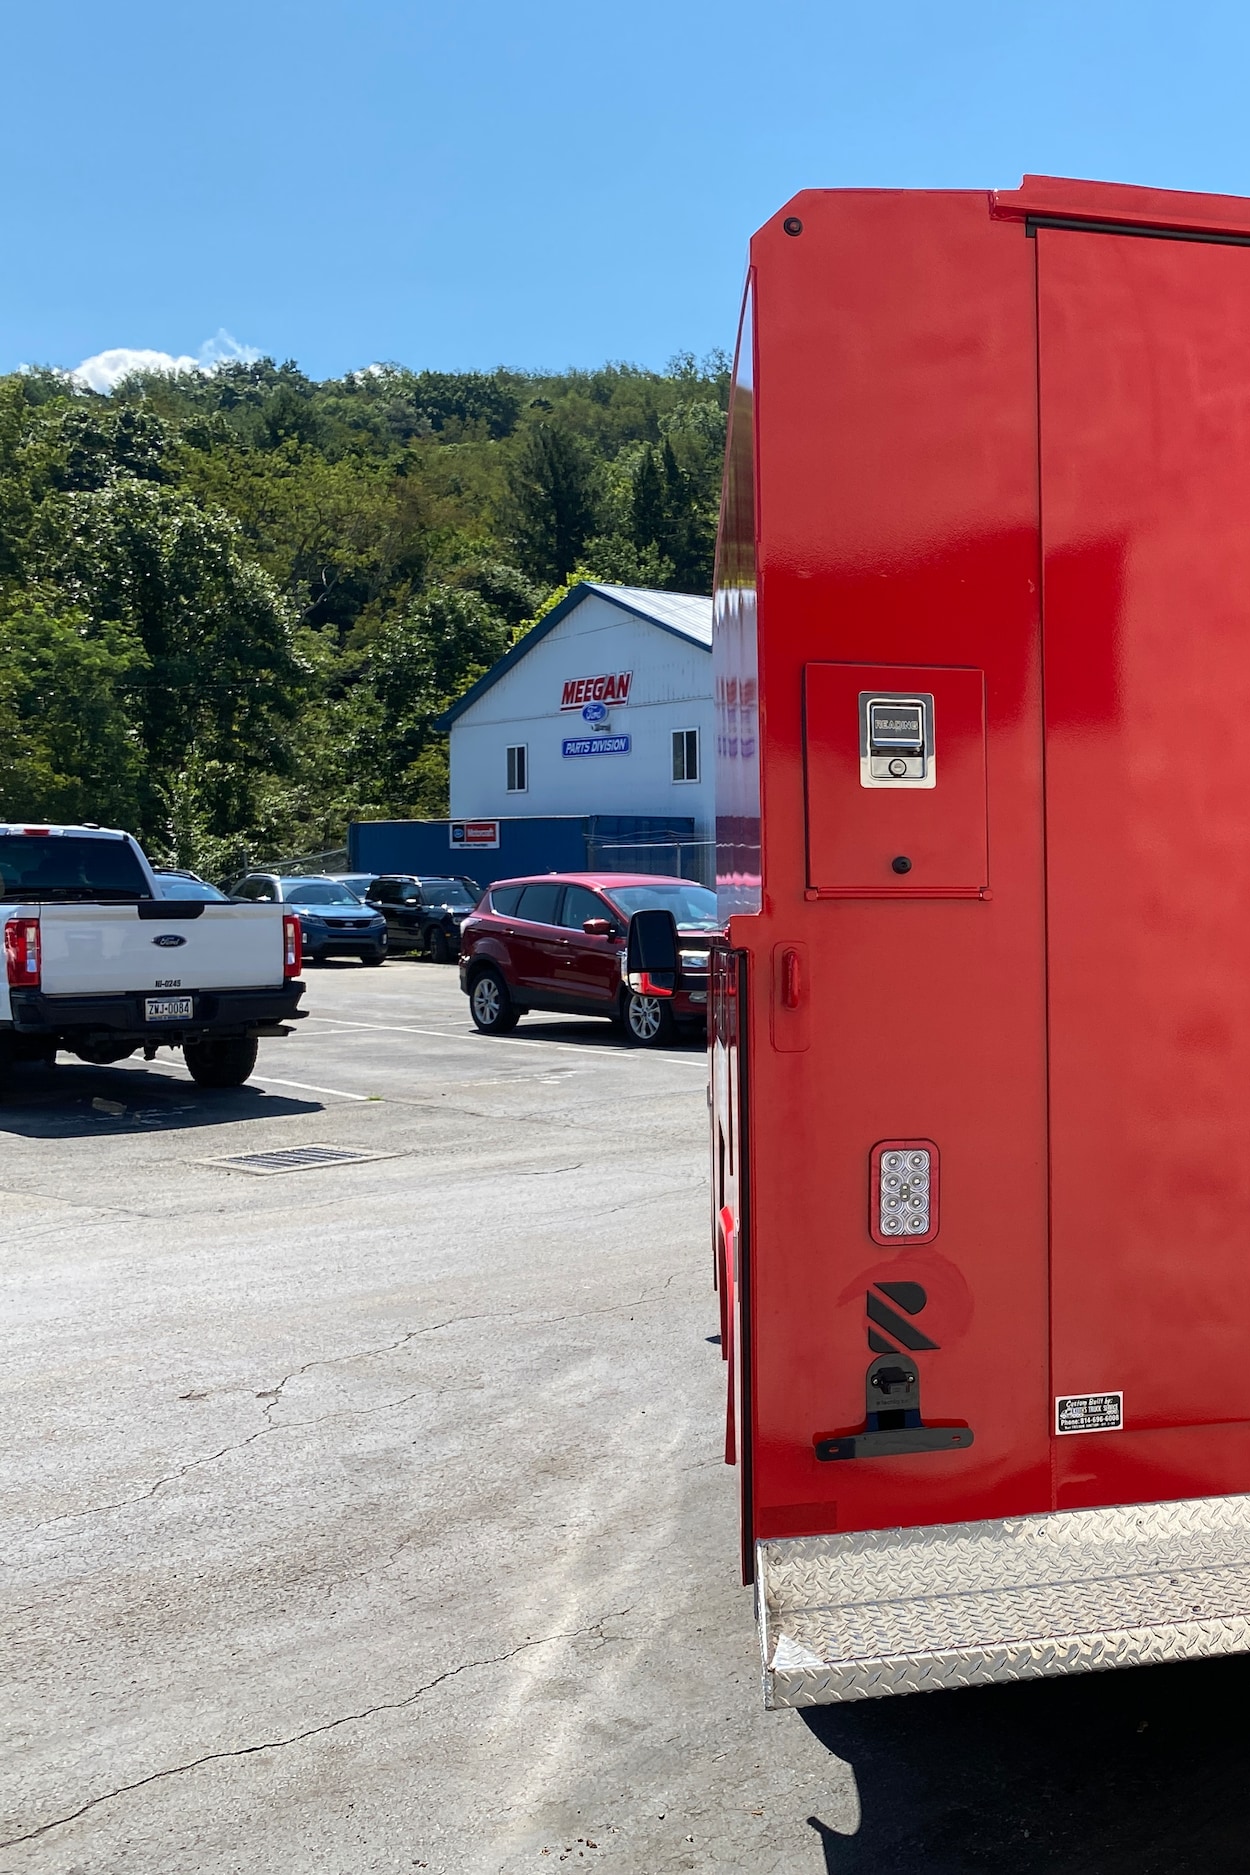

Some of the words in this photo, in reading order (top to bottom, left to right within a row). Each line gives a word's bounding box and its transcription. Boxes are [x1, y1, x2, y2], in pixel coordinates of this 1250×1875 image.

[560, 672, 632, 705] MEEGAN
[874, 719, 919, 731] READING
[565, 741, 591, 754] PARTS
[591, 738, 627, 752] DIVISION
[160, 936, 180, 946] Ford
